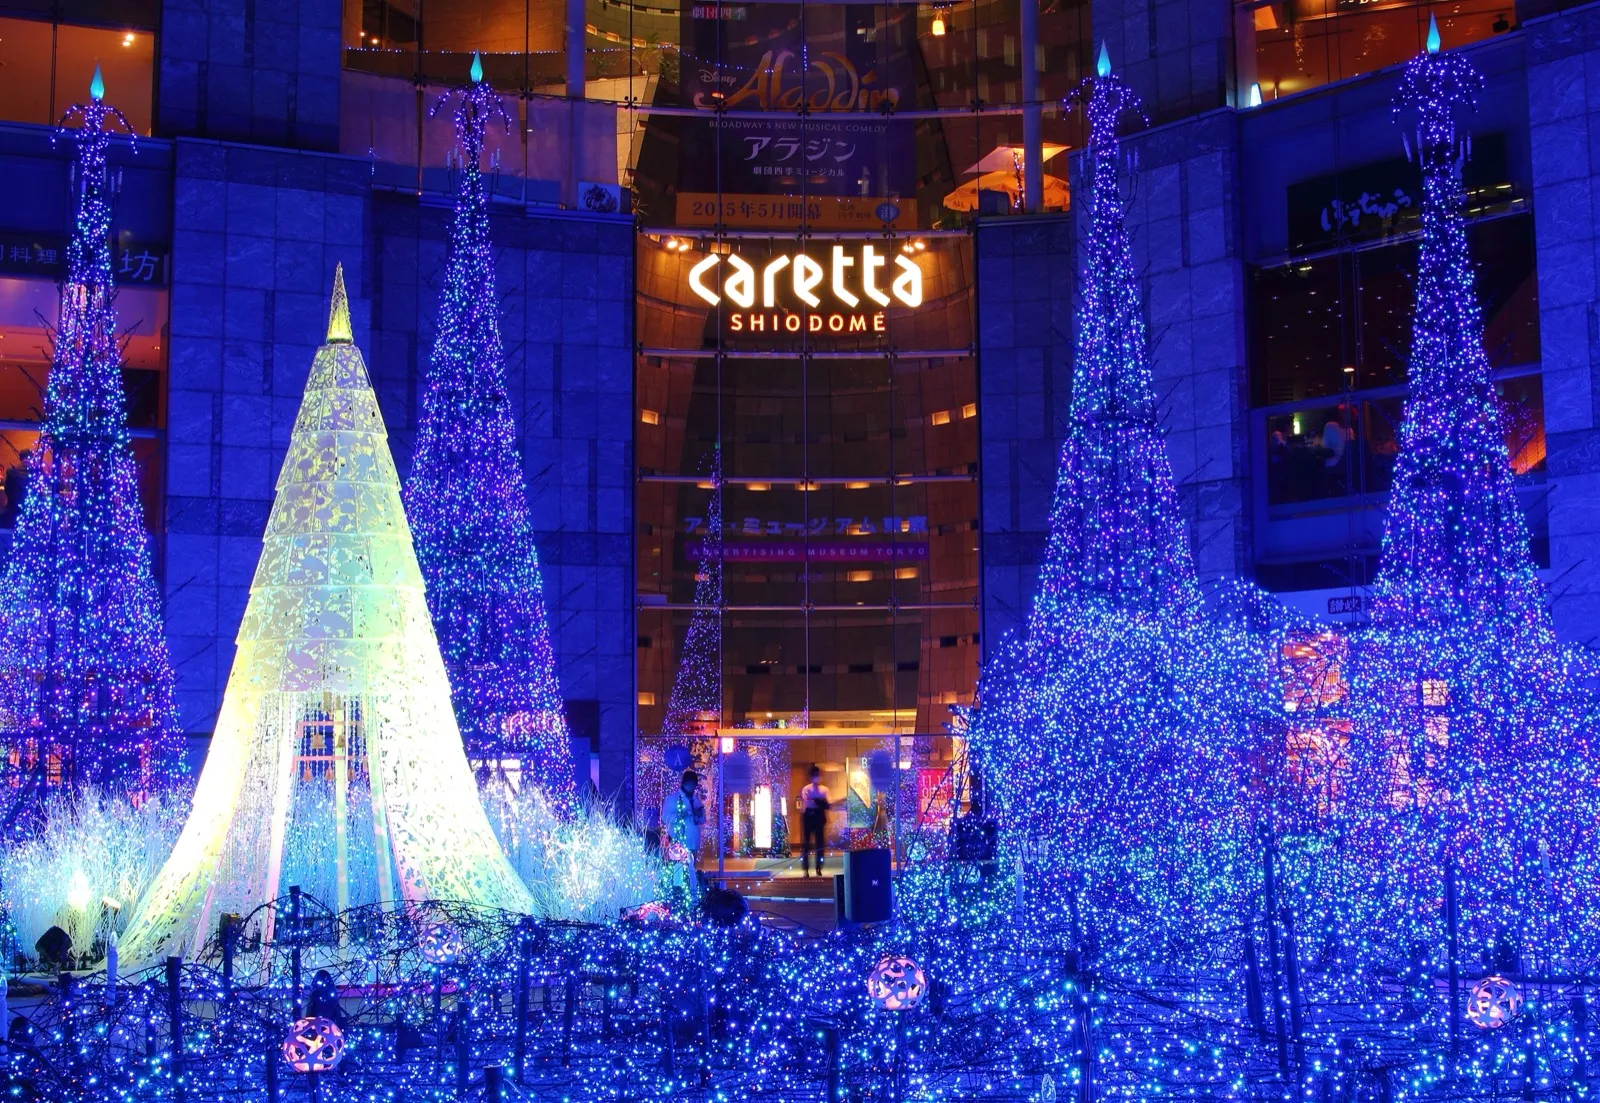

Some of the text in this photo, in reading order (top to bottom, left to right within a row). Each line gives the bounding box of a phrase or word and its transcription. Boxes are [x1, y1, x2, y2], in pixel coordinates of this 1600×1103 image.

[694, 50, 899, 111] Aladdin
[709, 120, 887, 133] BROADWAY'S NEW MUSICAL COMEDY
[743, 136, 856, 163] アラジン
[0, 245, 58, 264] 料理
[688, 245, 923, 308] caretta
[692, 548, 795, 557] ADVERTISING
[807, 548, 868, 556] MUSEUM
